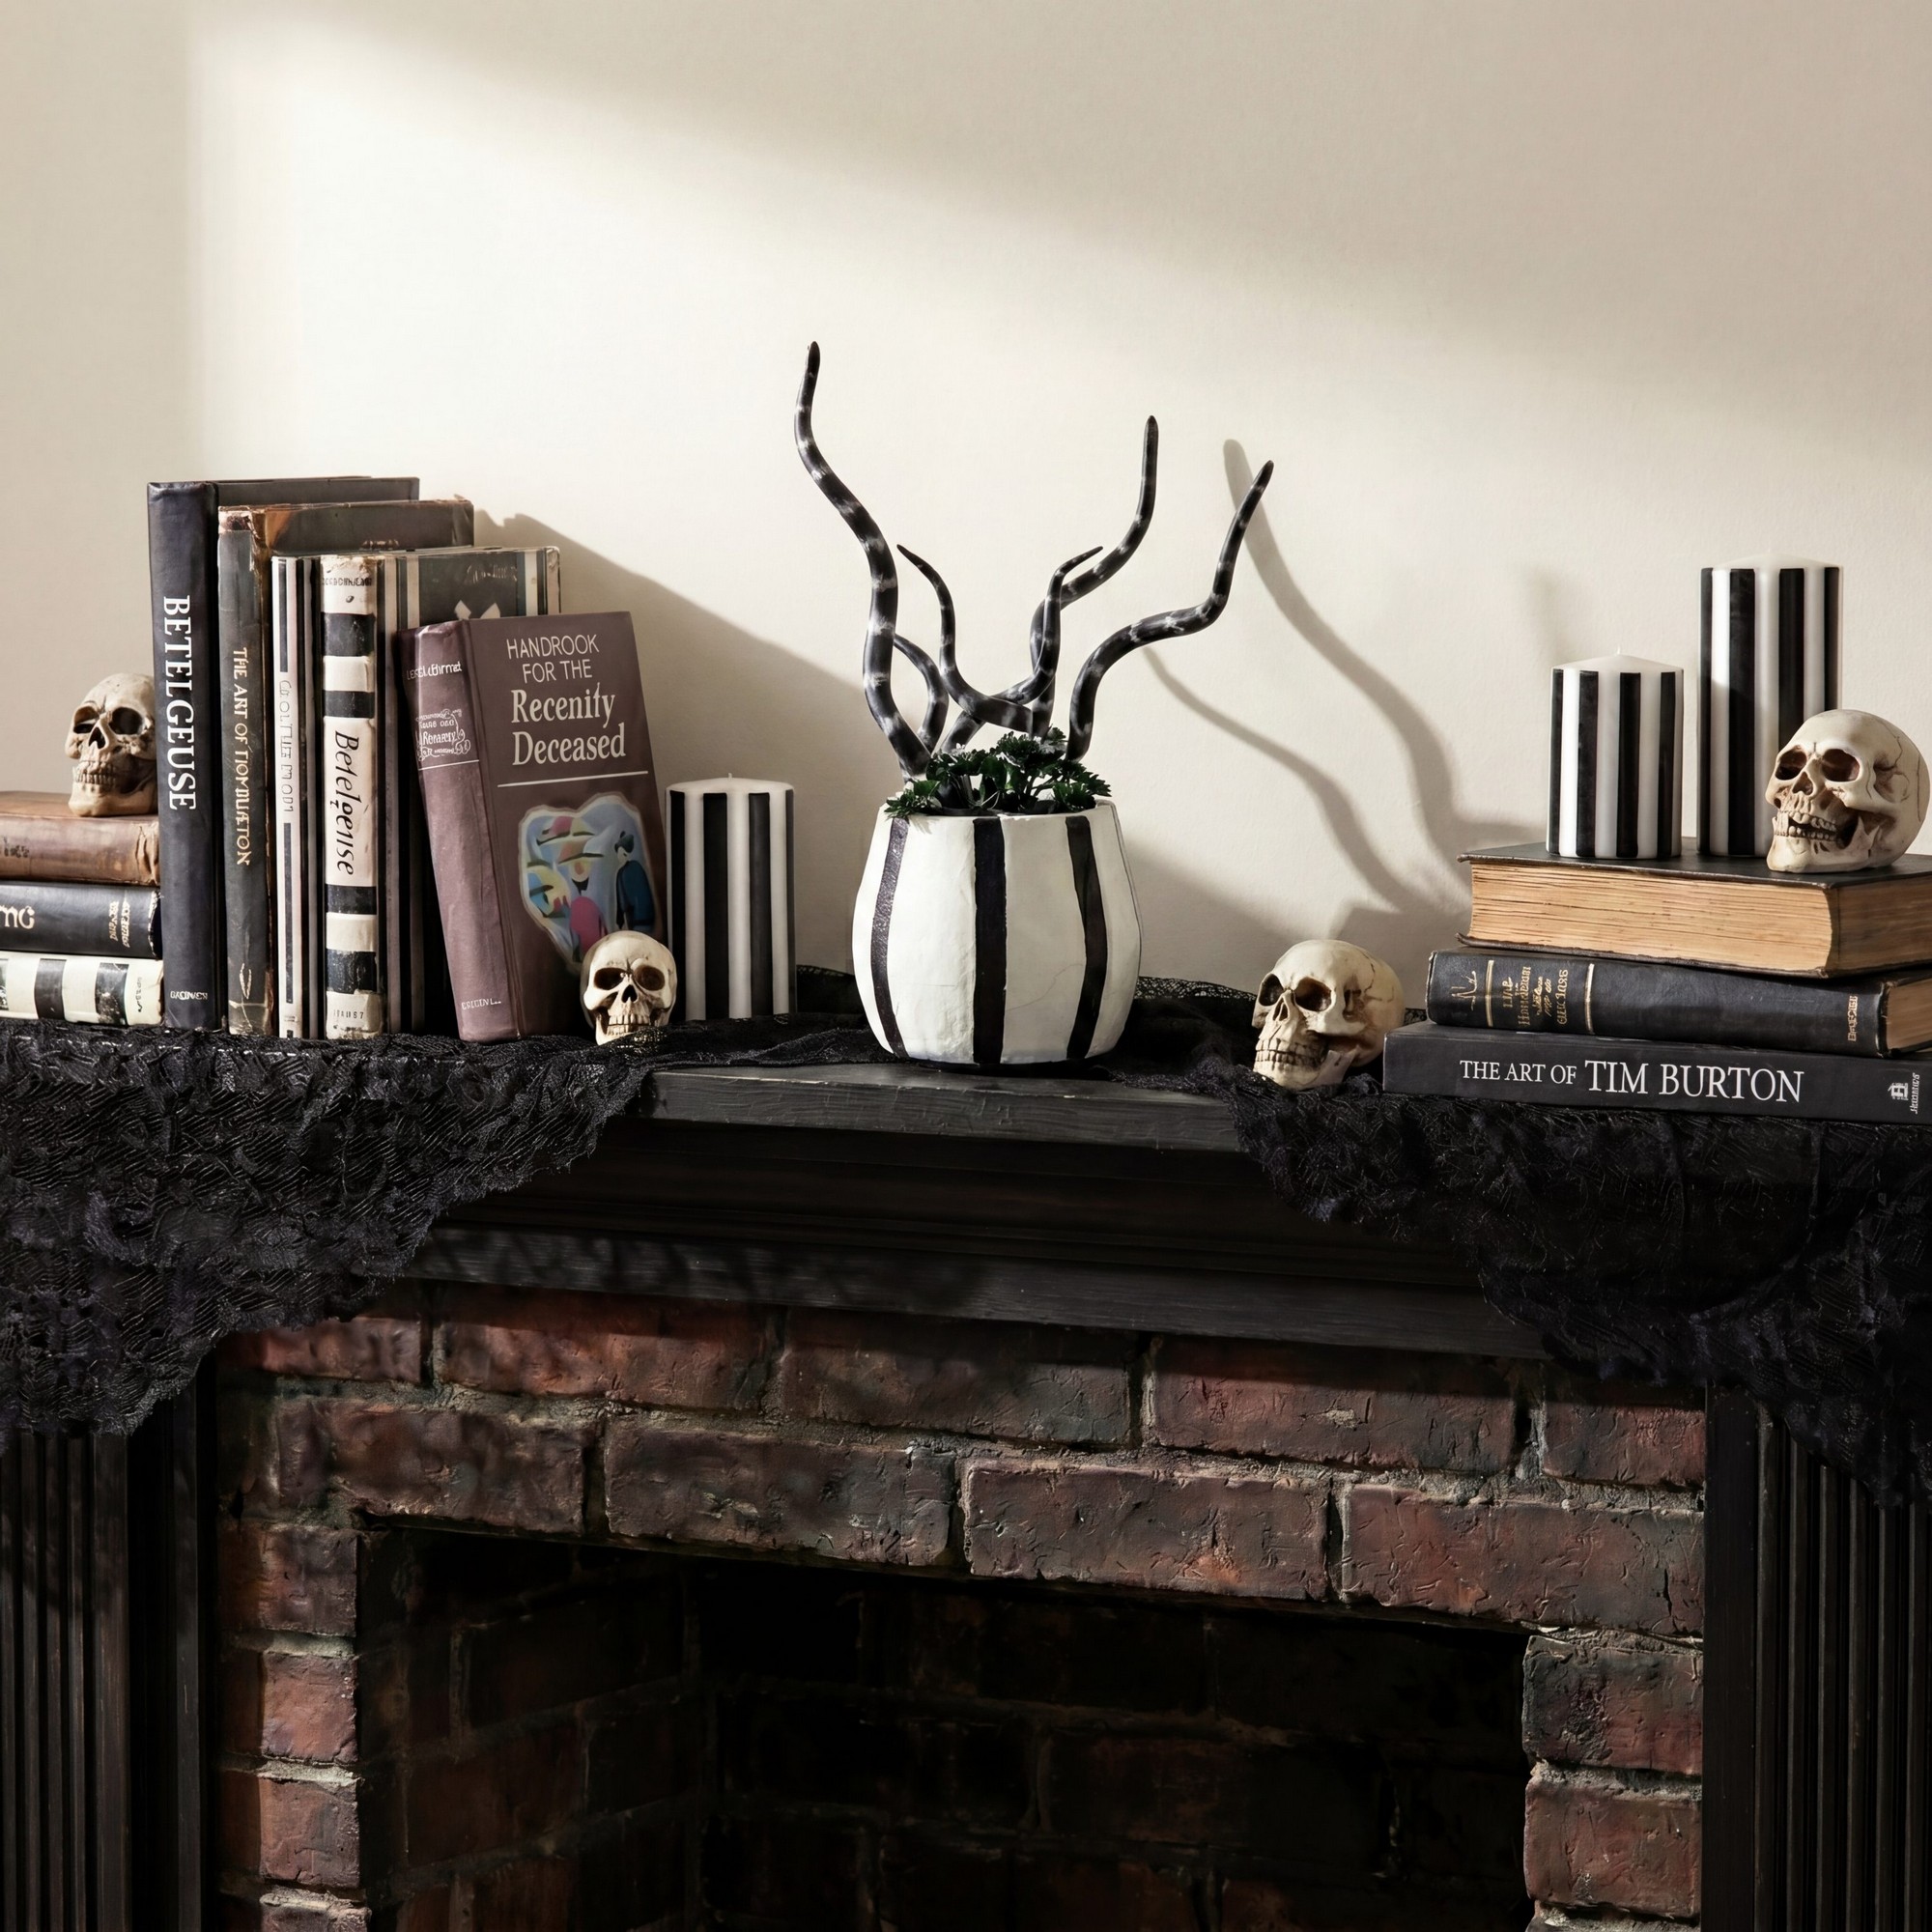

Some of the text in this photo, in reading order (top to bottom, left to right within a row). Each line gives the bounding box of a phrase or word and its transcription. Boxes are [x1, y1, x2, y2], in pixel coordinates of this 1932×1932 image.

[233, 647, 248, 679] THE
[506, 634, 600, 660] HANDROOK
[522, 659, 593, 684] FOR THE
[163, 595, 196, 810] BETELGEUSE
[234, 683, 248, 719] ART
[234, 723, 248, 744] OF
[512, 722, 626, 766] Deceased
[1460, 1060, 1804, 1103] THE ART OF TIM BURTON
